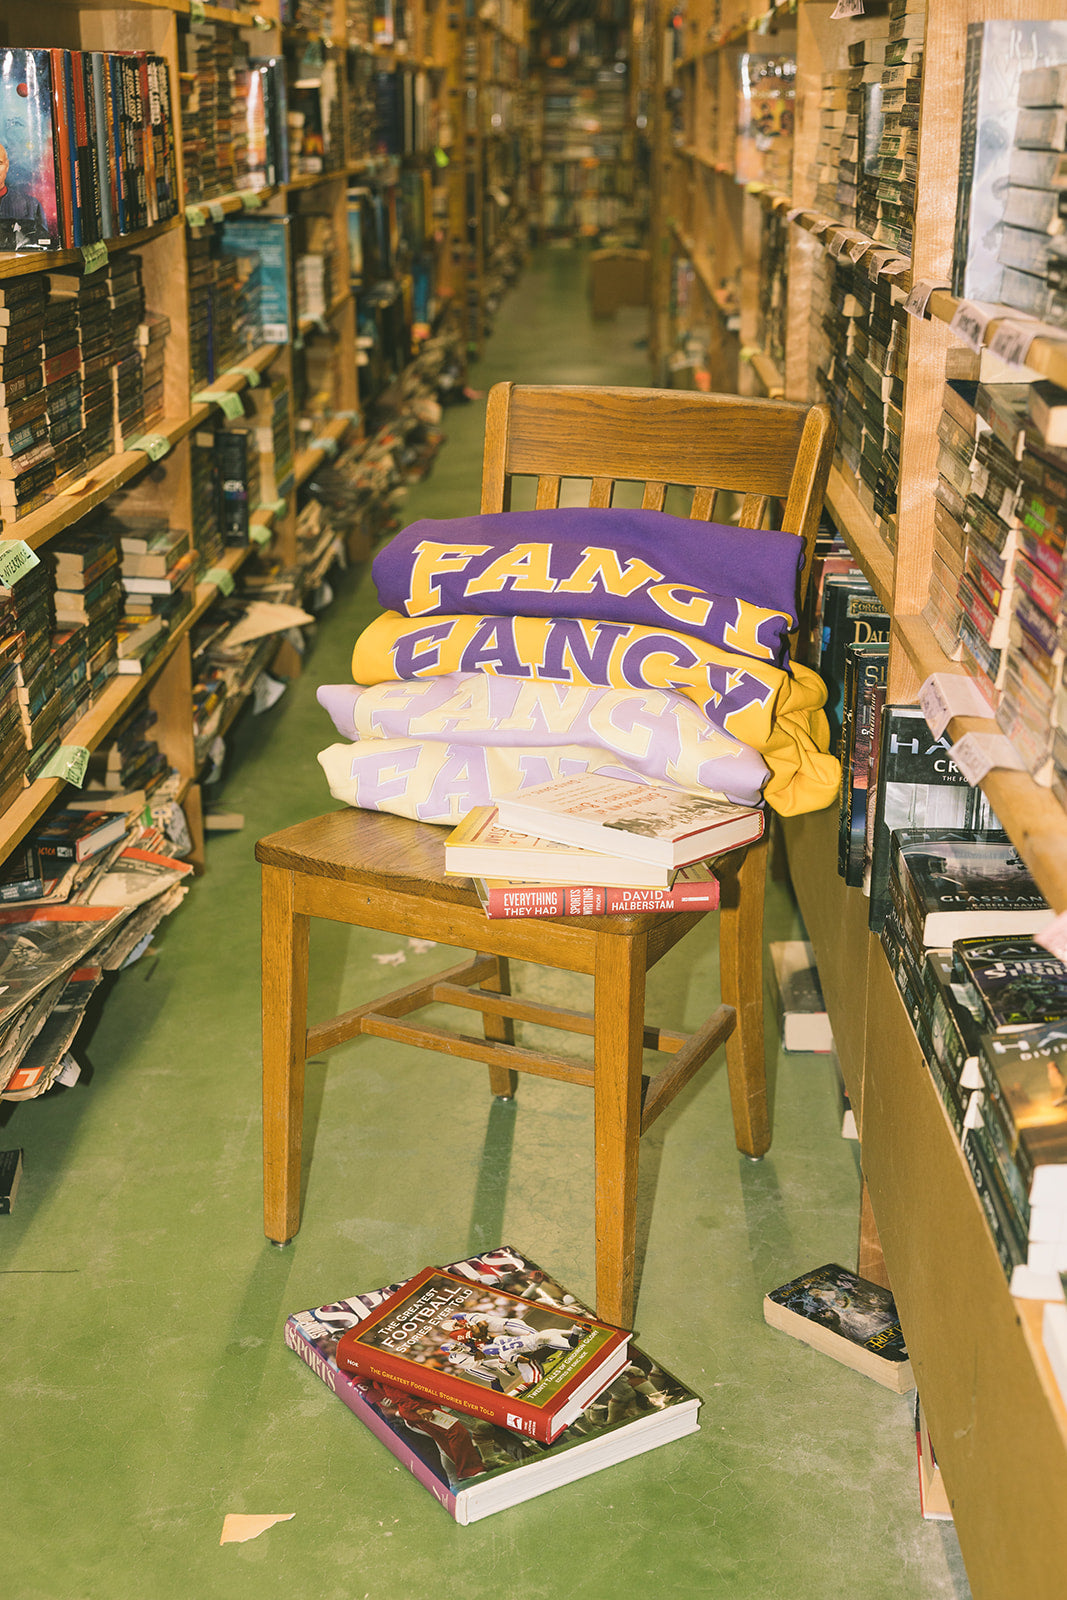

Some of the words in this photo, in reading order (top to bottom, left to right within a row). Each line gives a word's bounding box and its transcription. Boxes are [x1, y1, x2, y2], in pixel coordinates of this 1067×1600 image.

[404, 539, 793, 661] FANCY
[391, 616, 774, 730] FANCY
[350, 743, 654, 822] FAN
[504, 891, 558, 907] EVERYTHING
[504, 906, 532, 916] THEY
[532, 906, 557, 915] HAD
[569, 889, 581, 915] SPORTS
[582, 888, 594, 916] WRITING
[611, 900, 674, 911] HALBERSTAM
[623, 890, 664, 901] DAVID
[940, 895, 1046, 903] GLASSLAN
[378, 1320, 399, 1336] THE
[397, 1287, 439, 1323] GREATEST
[382, 1286, 462, 1349] FOOTBALL
[396, 1325, 433, 1354] STORIES
[430, 1306, 454, 1326] EVER
[450, 1289, 473, 1309] TOLD
[289, 1328, 336, 1392] SPORTS
[527, 1378, 550, 1400] TWENTY
[583, 1330, 600, 1345] GLORY
[370, 1366, 381, 1377] THE
[381, 1371, 411, 1387] GREATEST
[410, 1380, 439, 1397] FOOTBALL
[439, 1391, 463, 1406] STORIES
[463, 1400, 479, 1412] EVER
[479, 1406, 495, 1418] TOLD
